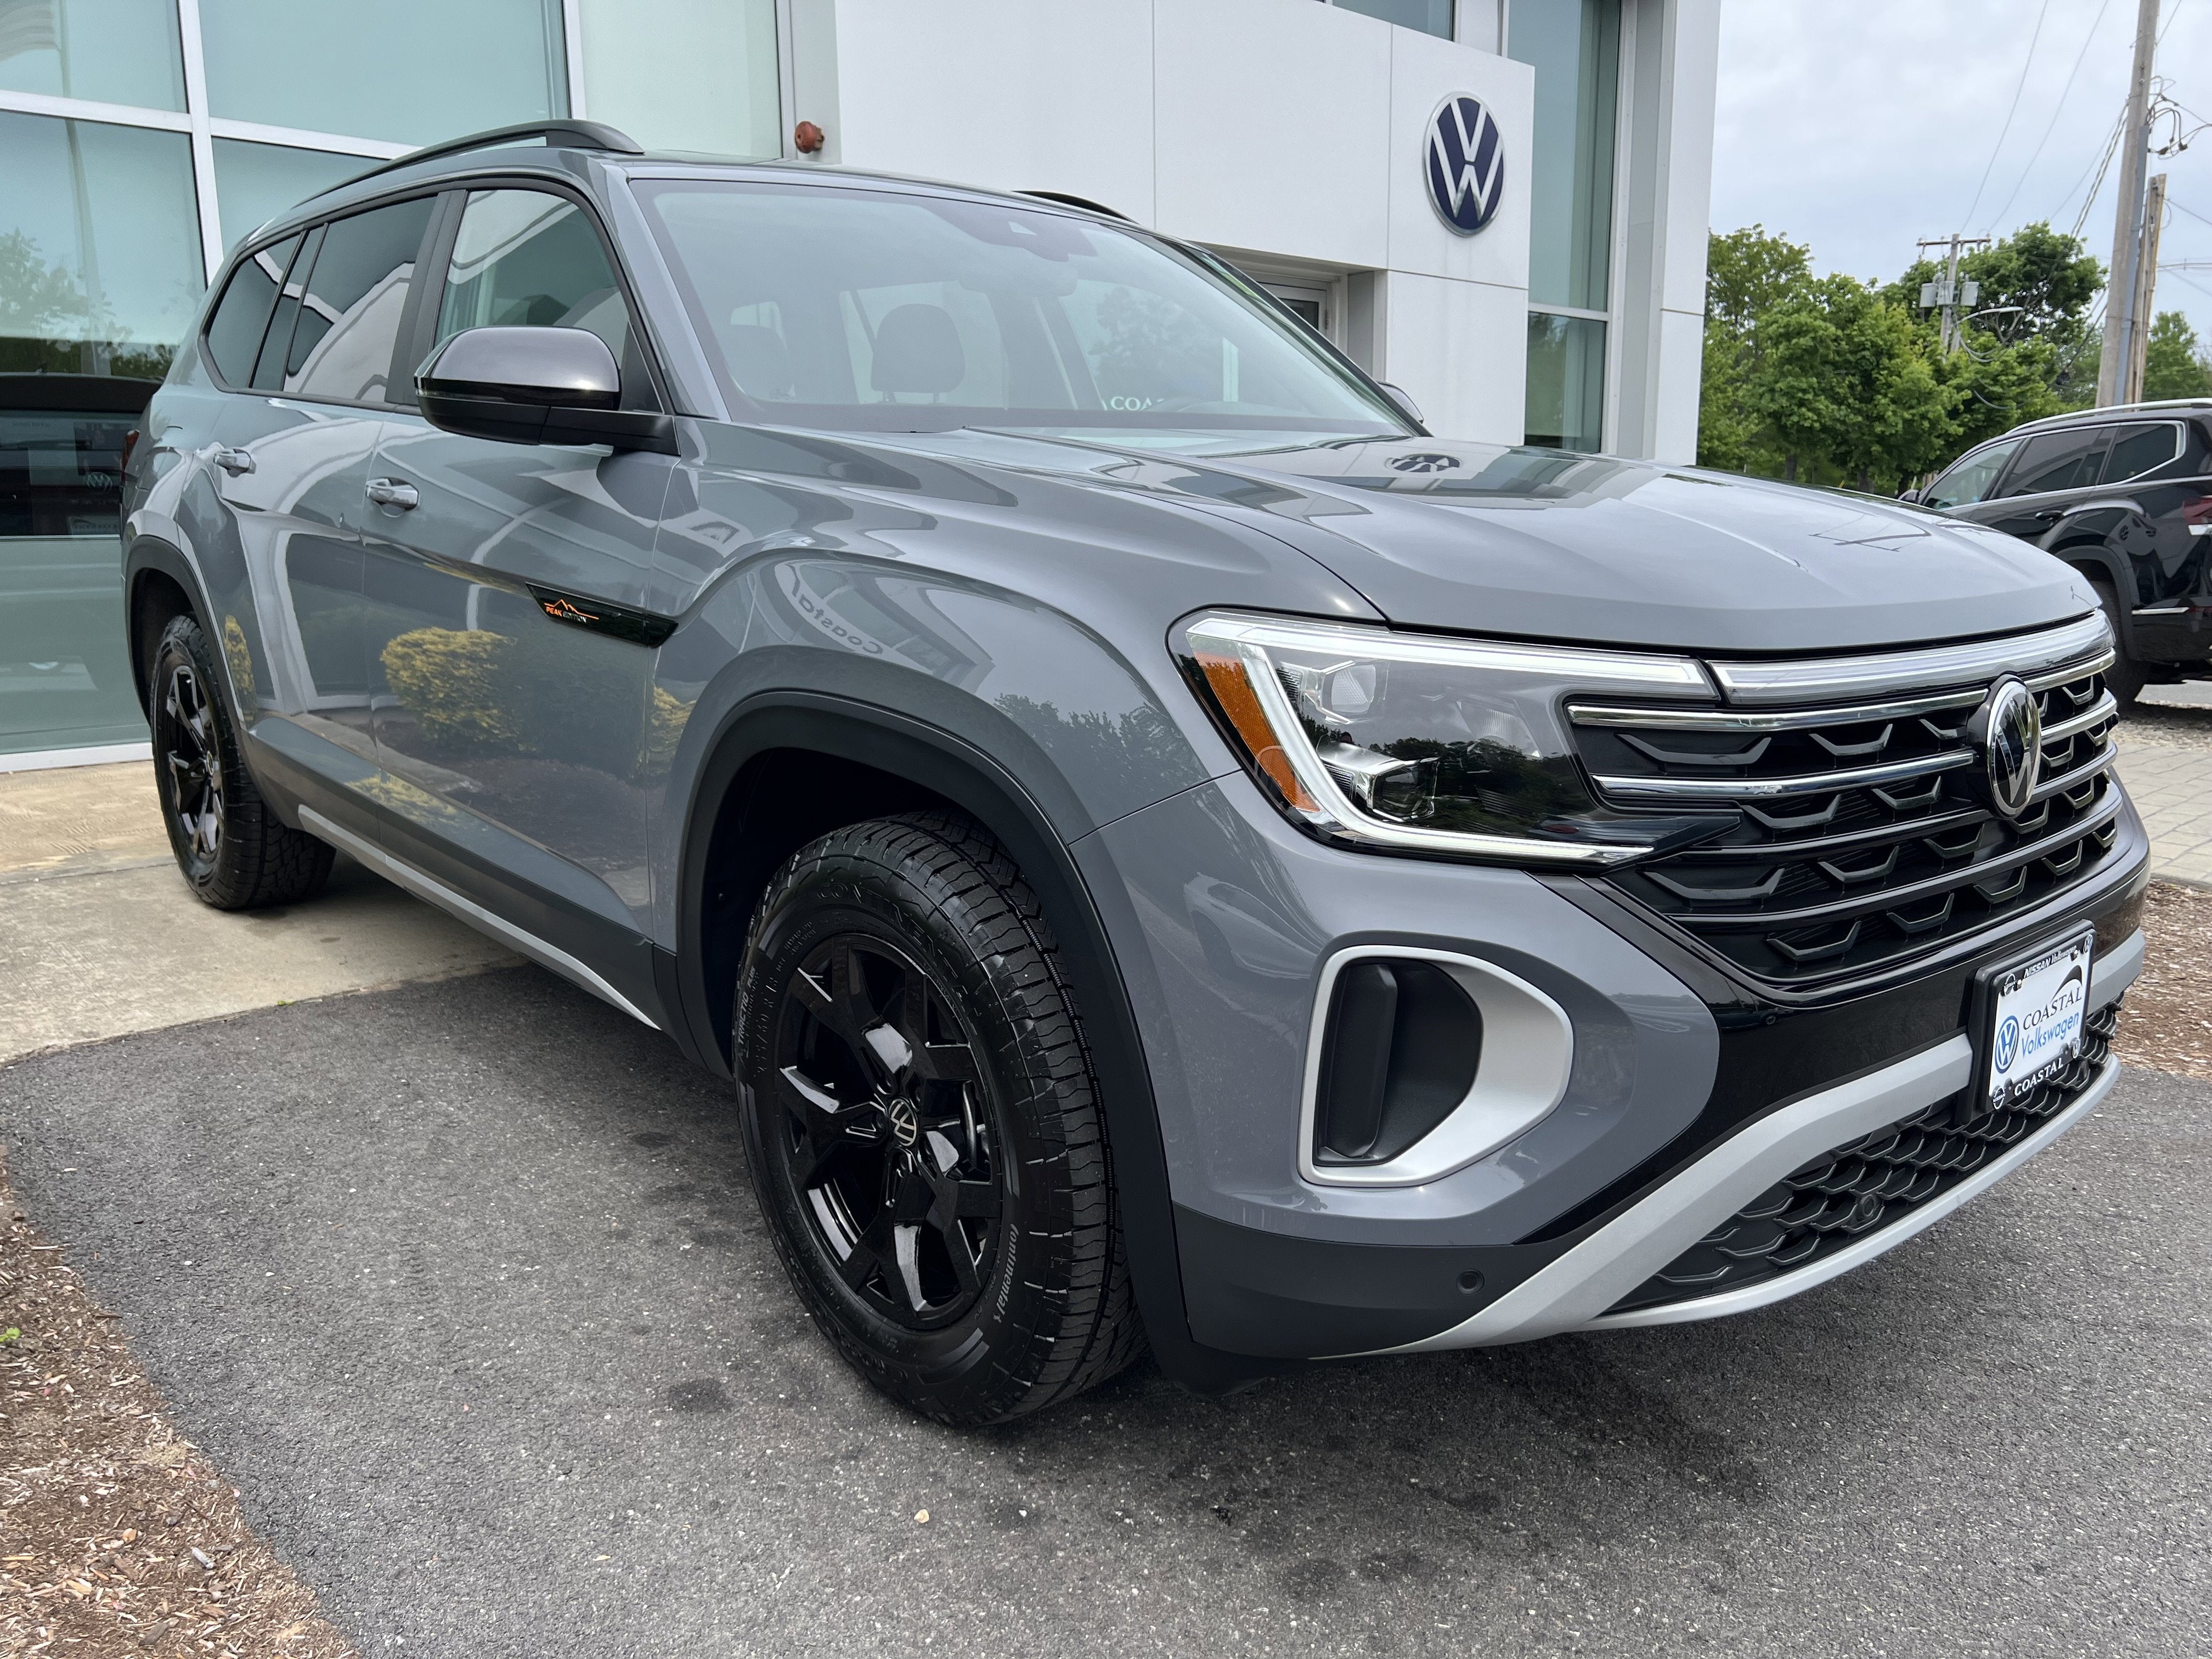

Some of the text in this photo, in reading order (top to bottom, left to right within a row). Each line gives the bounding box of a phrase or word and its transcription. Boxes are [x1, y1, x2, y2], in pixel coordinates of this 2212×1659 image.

[1422, 91, 1506, 238] VW
[1110, 396, 1164, 411] COA
[546, 606, 587, 624] PEAK EDITION
[2023, 957, 2051, 979] NISSAN
[2023, 986, 2083, 1030] COASTAL
[2021, 1012, 2079, 1058] Volkswagen
[2014, 1057, 2064, 1097] COASTAL
